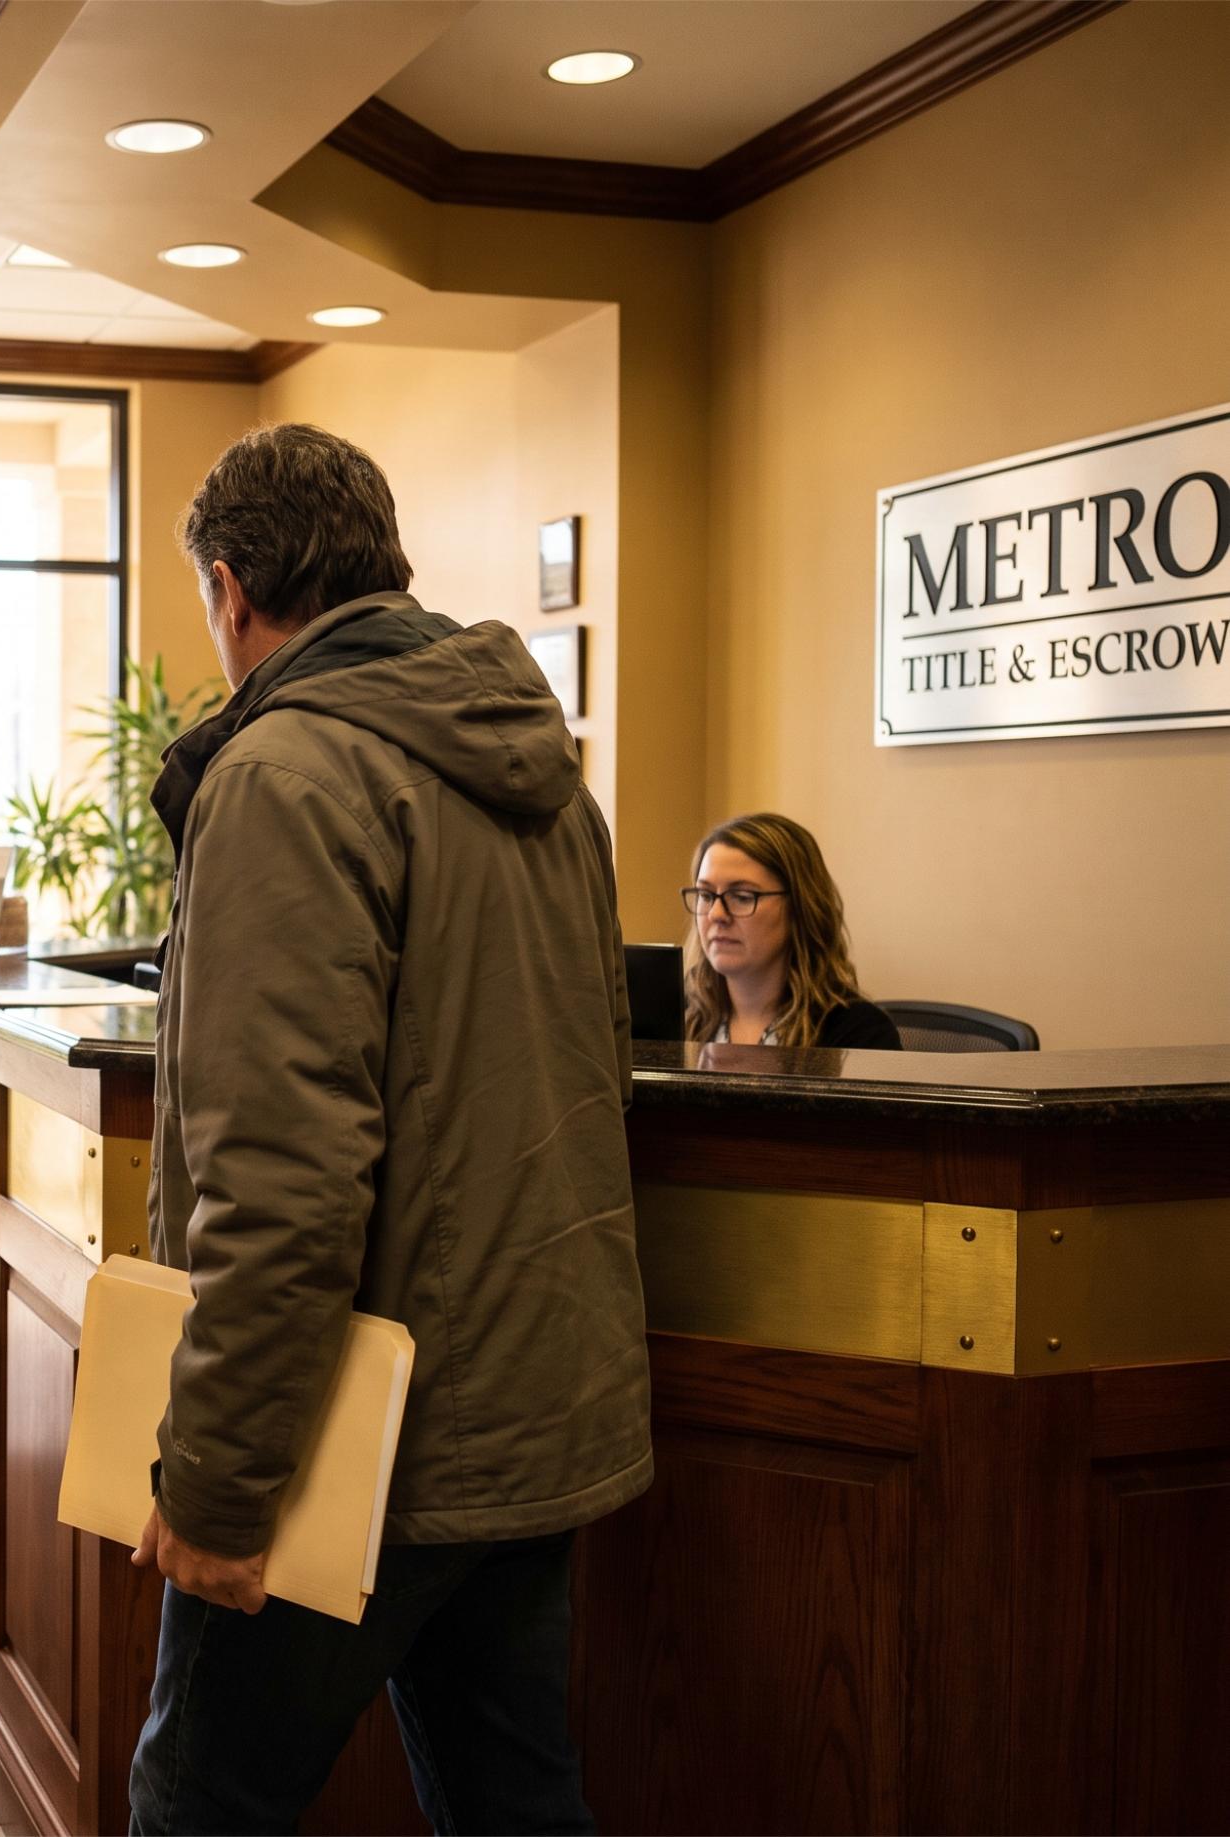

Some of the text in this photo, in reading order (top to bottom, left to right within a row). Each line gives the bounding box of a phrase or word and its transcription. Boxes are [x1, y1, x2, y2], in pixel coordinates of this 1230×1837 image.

[902, 470, 1230, 619] METRO
[902, 619, 1230, 692] TITLE & ESCROW
